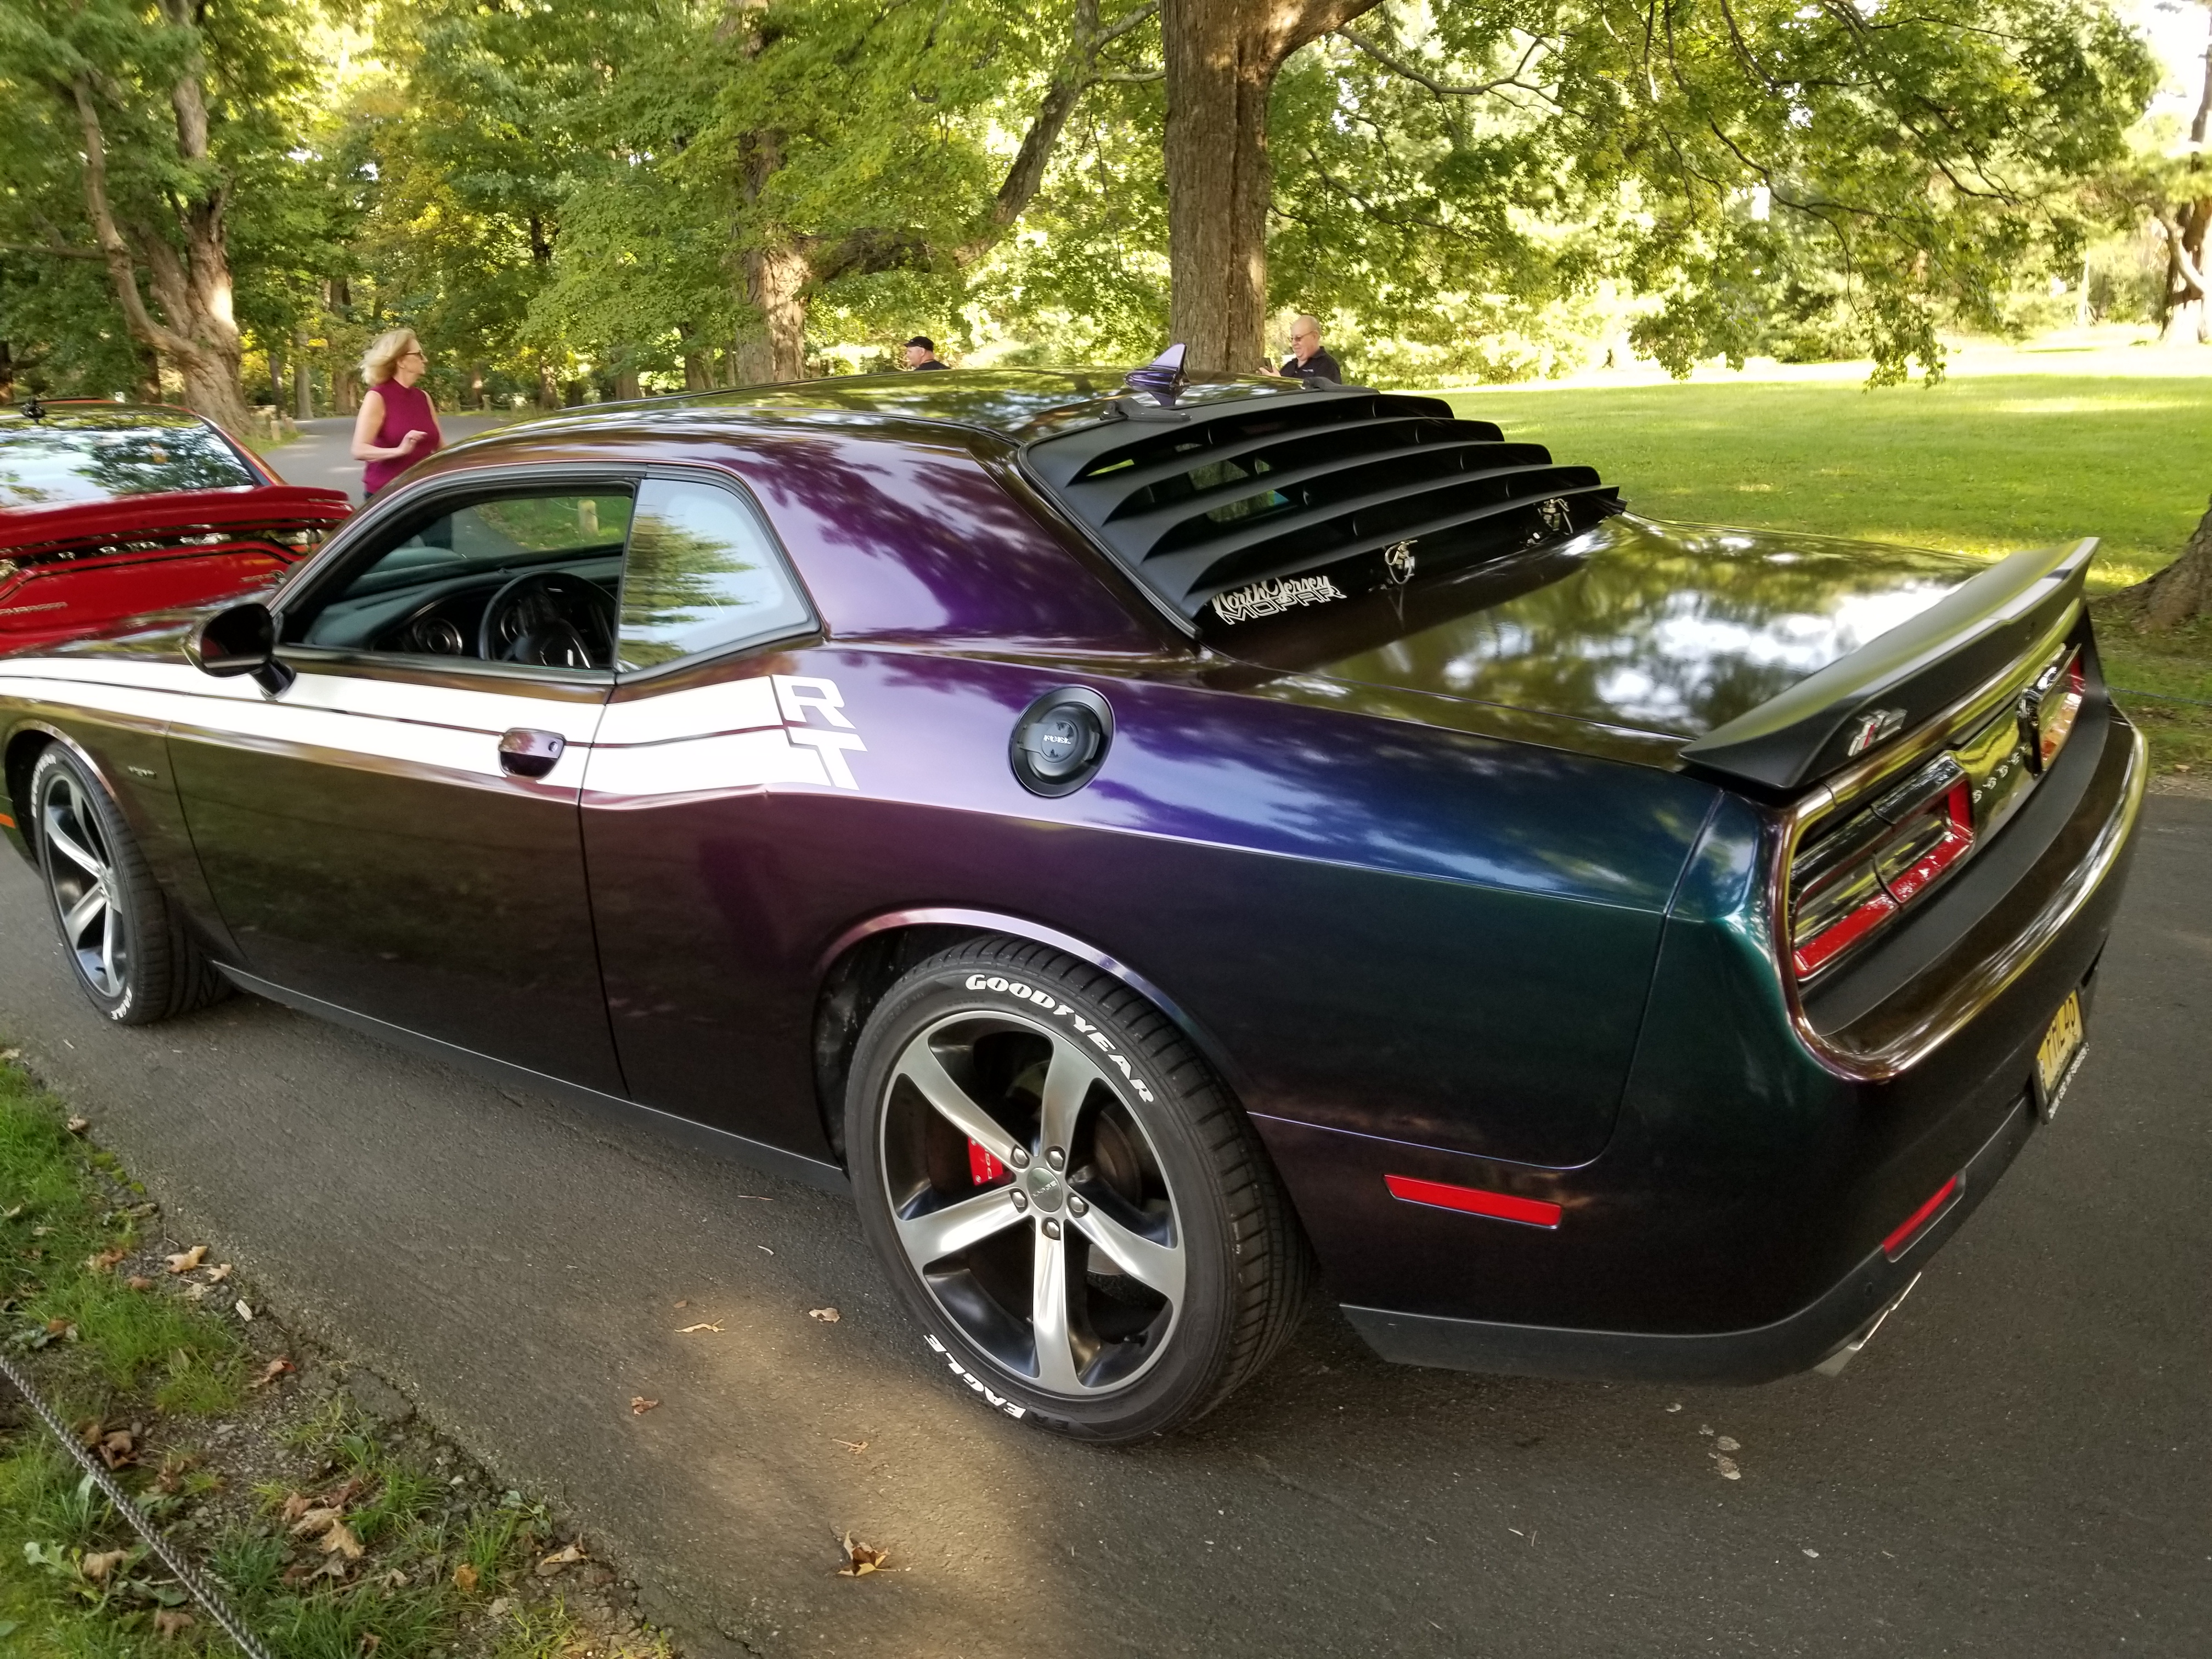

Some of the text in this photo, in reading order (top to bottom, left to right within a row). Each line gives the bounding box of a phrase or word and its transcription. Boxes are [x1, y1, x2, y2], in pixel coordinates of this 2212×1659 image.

[1211, 575, 1337, 618] North Jersey
[1216, 585, 1347, 625] MOPAR
[1043, 735, 1071, 744] FUEL
[965, 974, 1154, 1103] GOODYEAR
[923, 1334, 1026, 1419] EAGLE
